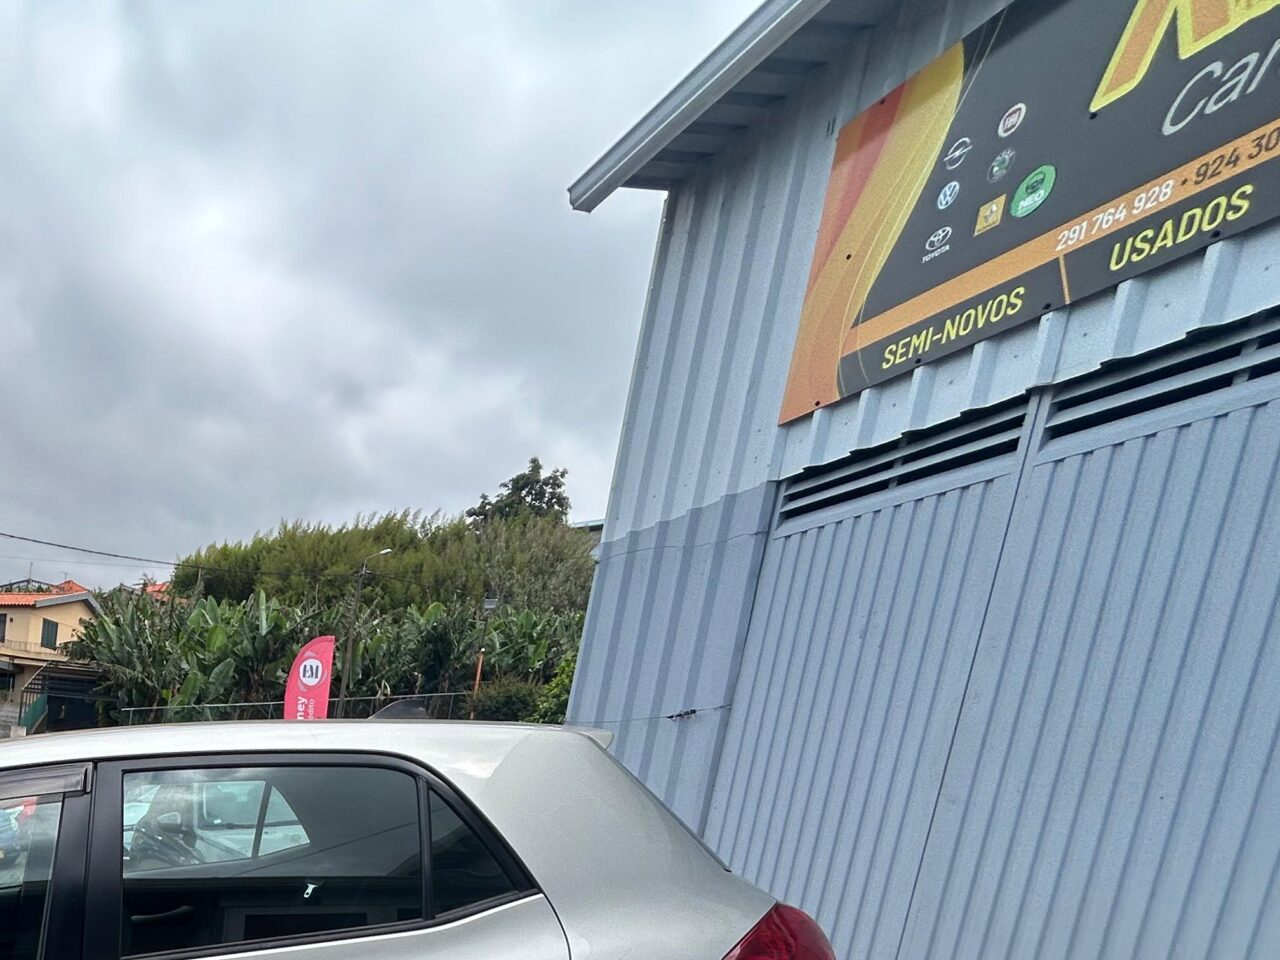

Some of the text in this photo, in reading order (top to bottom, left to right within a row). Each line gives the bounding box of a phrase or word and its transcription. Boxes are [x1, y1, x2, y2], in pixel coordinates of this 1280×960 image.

[1056, 220, 1087, 250] 291
[1091, 205, 1128, 235] 764
[1131, 179, 1175, 215] 928
[1194, 146, 1240, 185] 924
[1109, 184, 1254, 271] USADOS
[921, 244, 950, 263] TOYOTA
[881, 286, 1025, 369] SEMI-NOVOS
